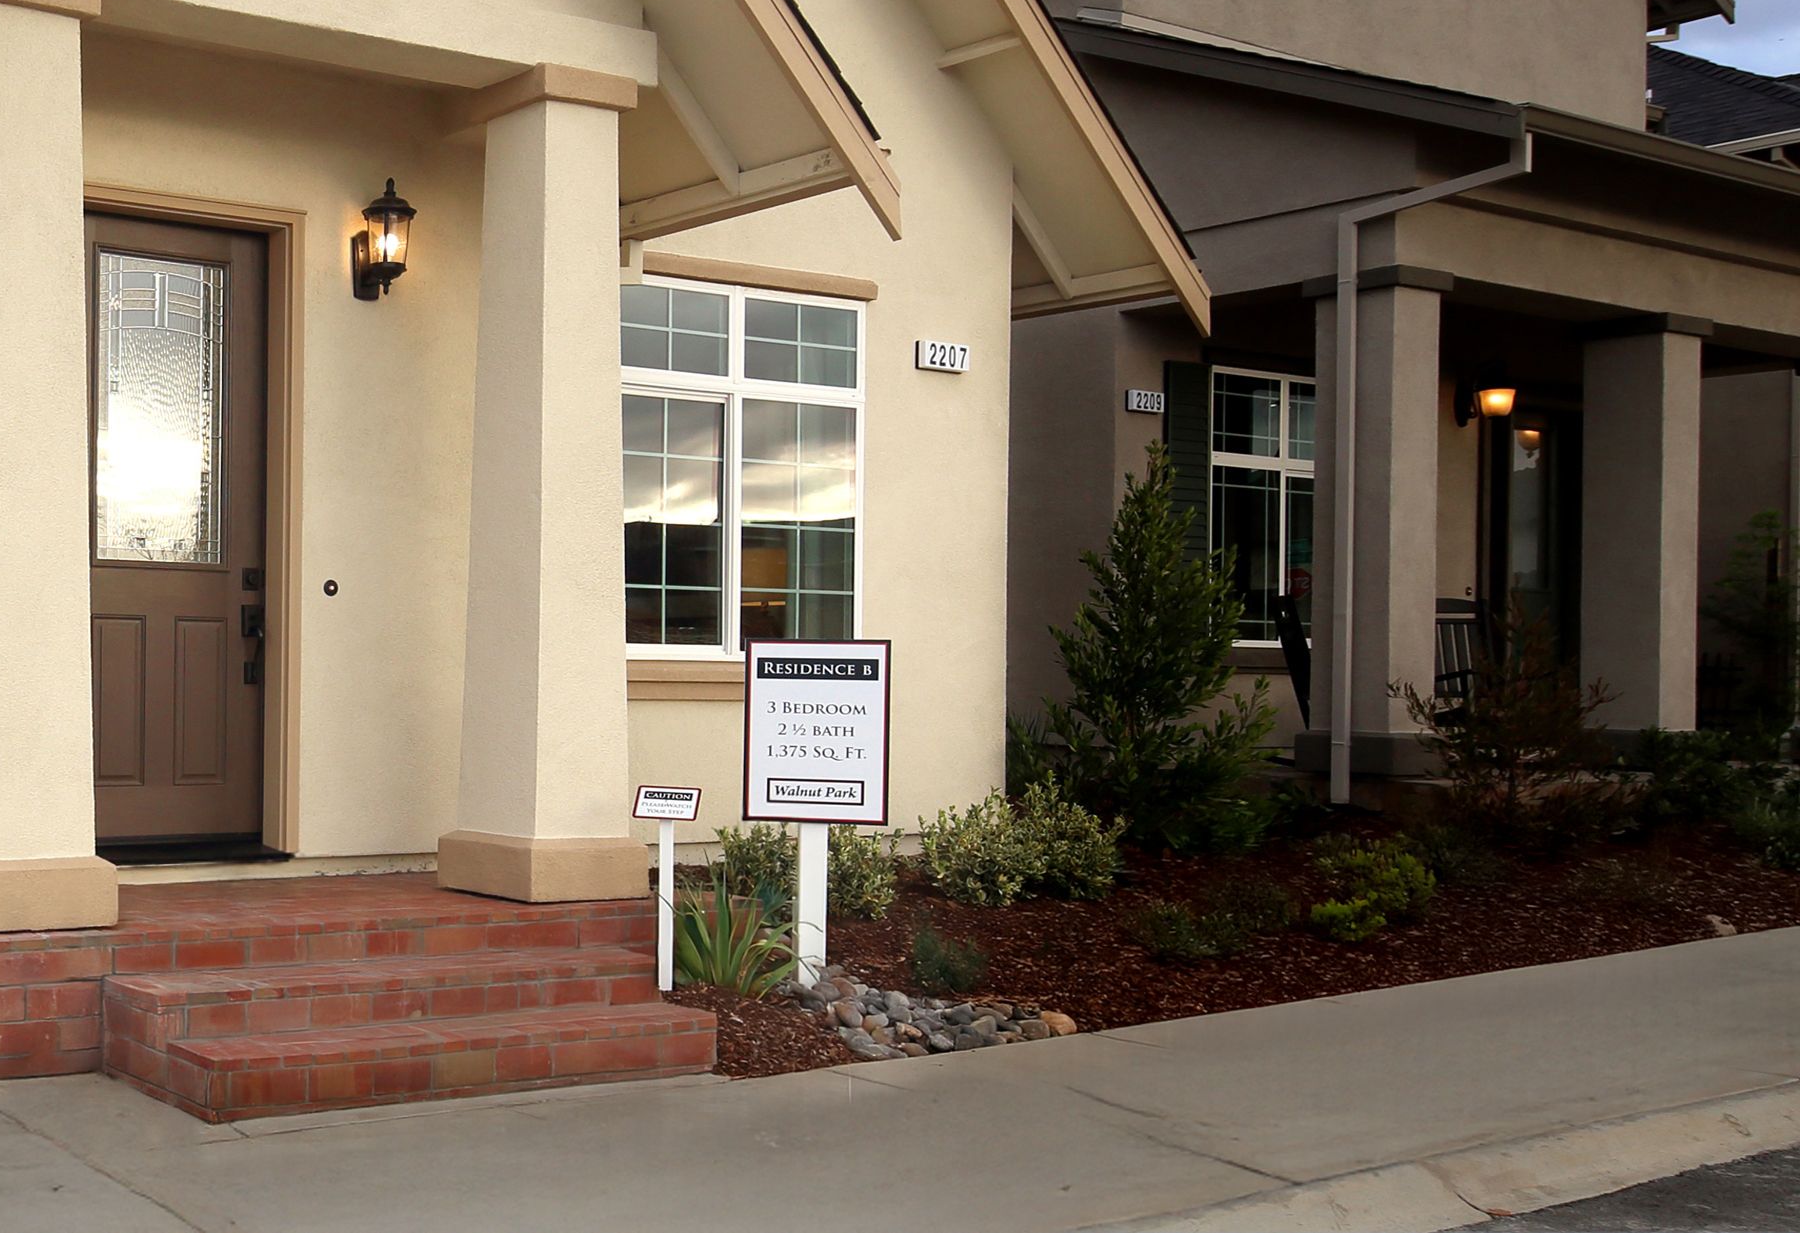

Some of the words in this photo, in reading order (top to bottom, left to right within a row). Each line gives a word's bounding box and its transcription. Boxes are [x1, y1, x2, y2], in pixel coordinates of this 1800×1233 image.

[929, 343, 967, 369] 2207
[1136, 392, 1162, 411] 2209
[764, 662, 856, 676] RESIDENCE
[863, 665, 872, 676] B
[767, 701, 776, 714] 3
[783, 701, 867, 715] BEDROOM
[778, 723, 787, 736] 2
[813, 725, 854, 737] BATH
[767, 745, 807, 758] 1,375
[813, 746, 844, 761] SQ.
[845, 747, 867, 759] FT.
[646, 792, 691, 800] CAUTION
[775, 785, 822, 797] Walnut
[824, 787, 857, 799] Park
